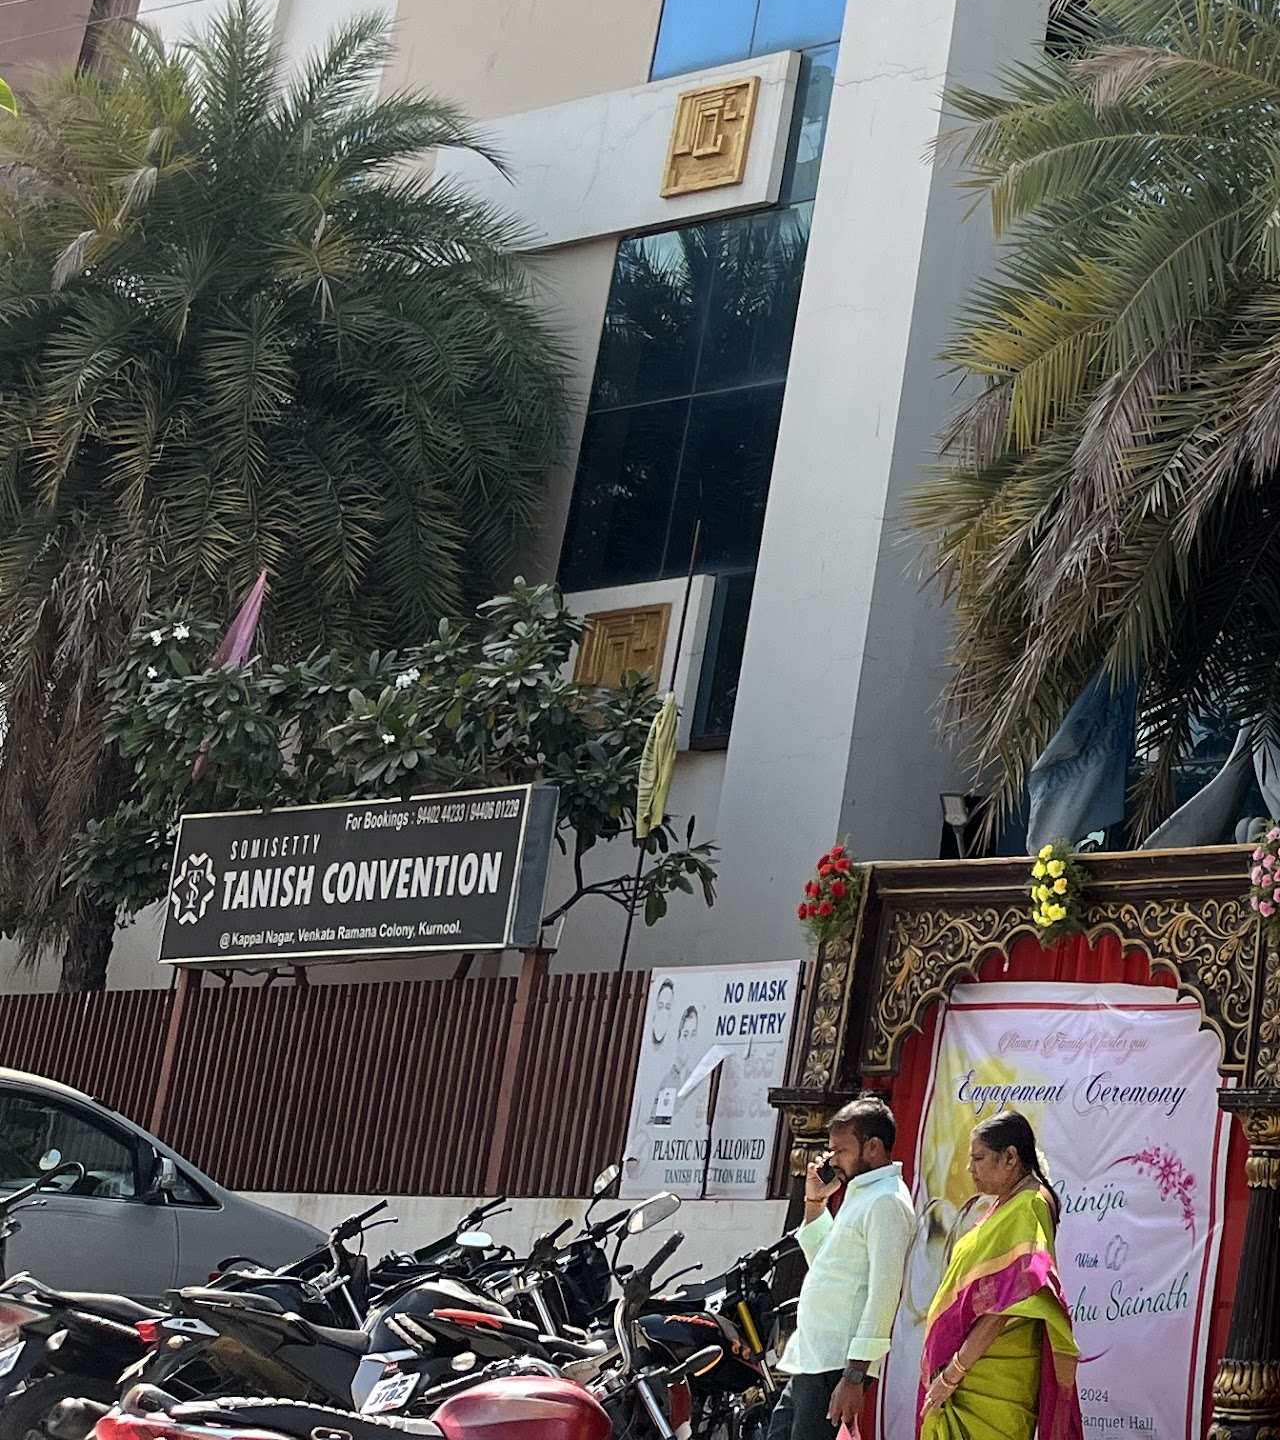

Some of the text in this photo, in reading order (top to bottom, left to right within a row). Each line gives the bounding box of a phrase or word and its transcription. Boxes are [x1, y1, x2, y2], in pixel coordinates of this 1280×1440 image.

[345, 813, 361, 831] For
[363, 809, 409, 831] Bookings
[441, 803, 464, 823] 44233
[494, 799, 520, 818] 01229
[229, 834, 321, 861] SOMISETTY
[222, 851, 503, 910] TANISH CONVENTION
[219, 920, 462, 949] @ Kappal Nagar, Venkata Ramana Colony, Kurnool.
[724, 979, 789, 1004] NO MASK
[715, 1012, 787, 1037] NO ENTRY
[953, 1069, 1188, 1117] Engagement Ceremony
[652, 1139, 692, 1161] PLASTIC
[713, 1138, 766, 1160] ALLOWED
[664, 1167, 756, 1184] TANISH FUCTION HALL
[1074, 1252, 1100, 1269] With
[1105, 1271, 1191, 1321] Sainath
[1080, 1388, 1109, 1402] 2024
[1081, 1416, 1125, 1431] anquet
